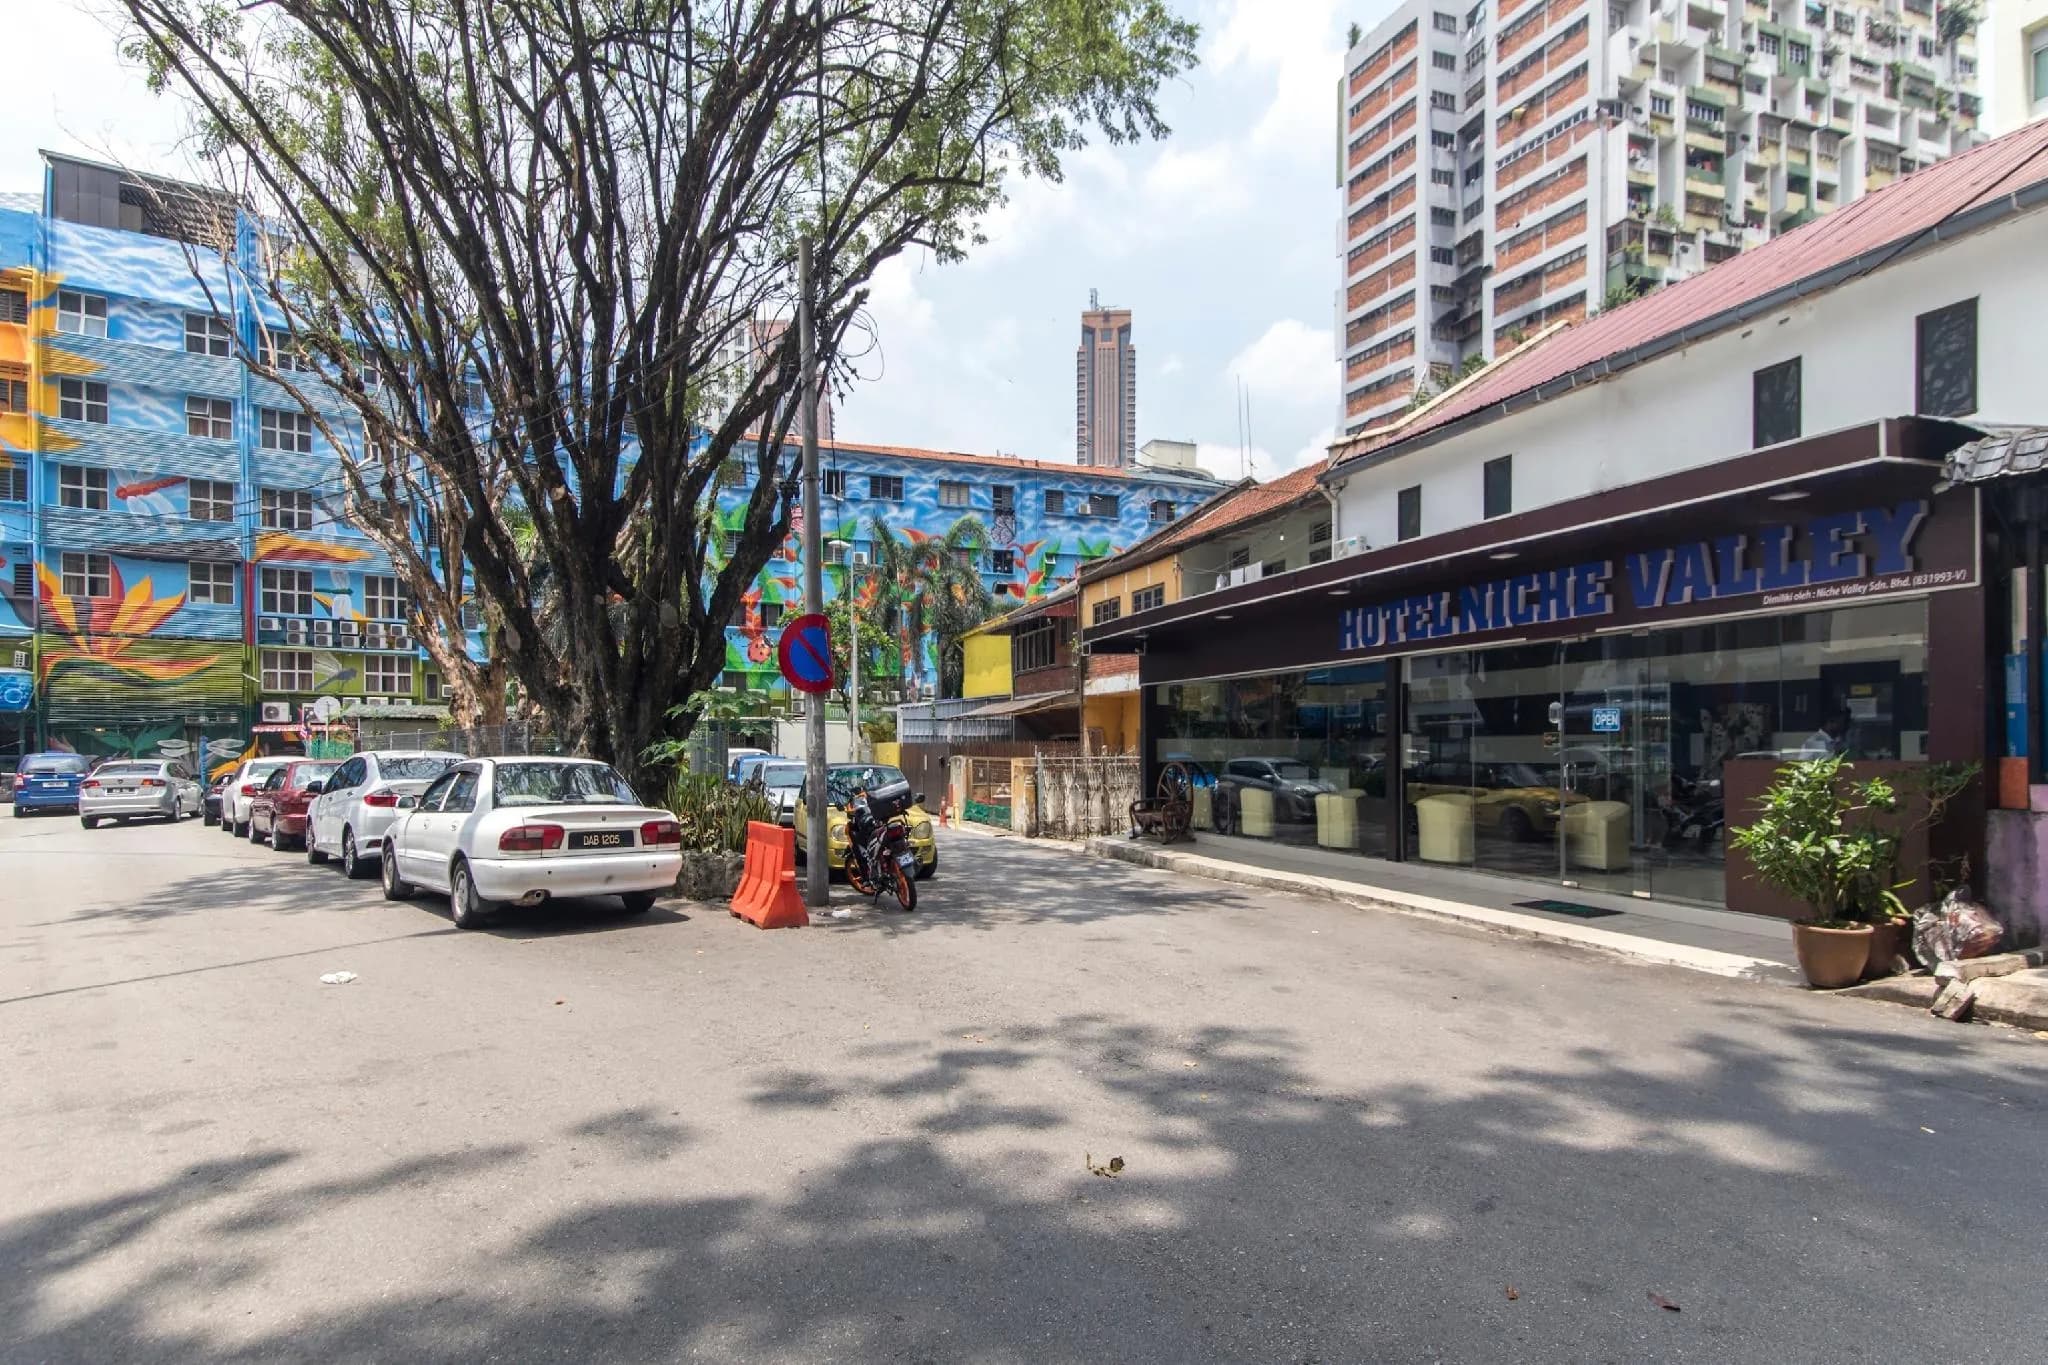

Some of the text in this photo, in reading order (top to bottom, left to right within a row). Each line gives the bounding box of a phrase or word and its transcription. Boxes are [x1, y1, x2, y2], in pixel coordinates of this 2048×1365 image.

[1338, 499, 1930, 651] HOTEL NICHE VALLEY
[1816, 585, 1841, 598] Niche
[1842, 582, 1868, 595] Valley
[1869, 579, 1889, 592] Sdn.
[1890, 576, 1911, 589] Bhd.
[1595, 713, 1618, 726] OPEN
[583, 834, 620, 846] DAB 1205
